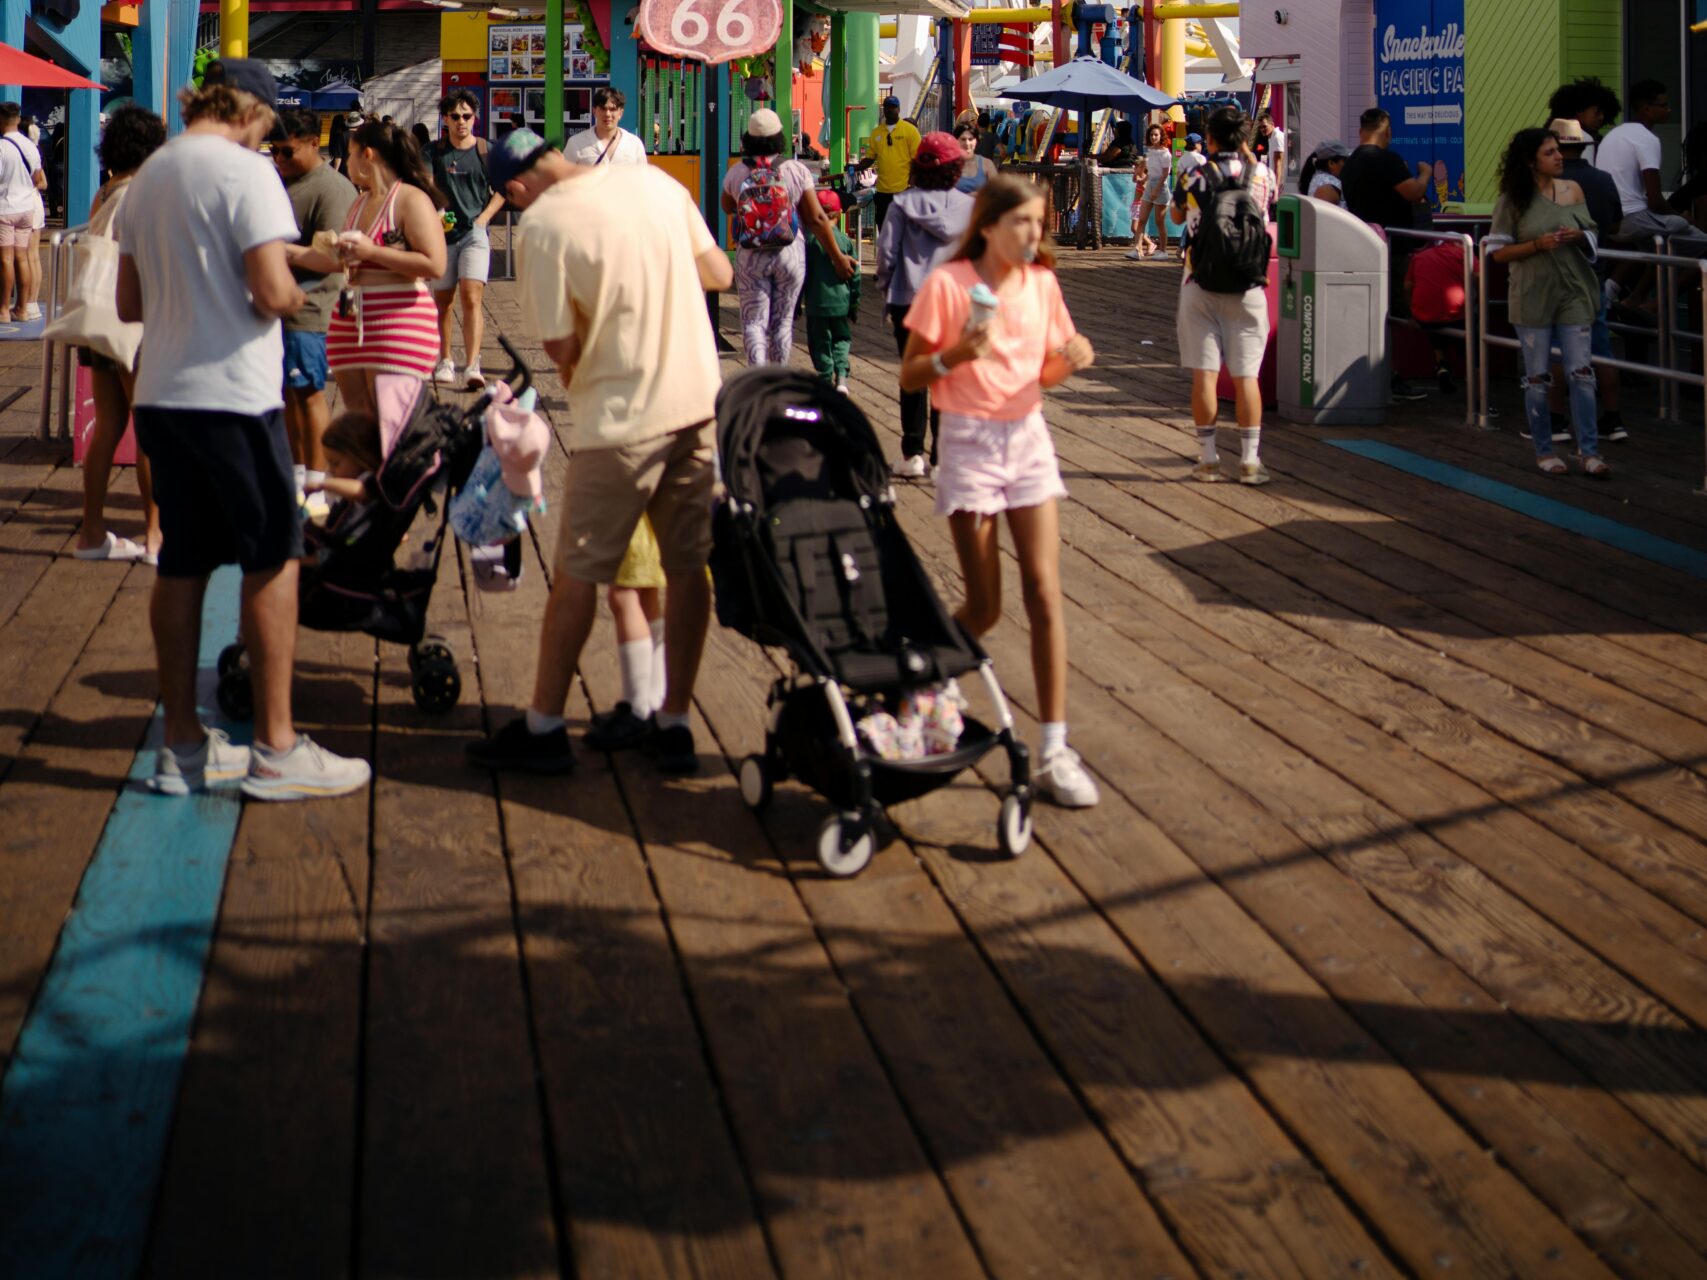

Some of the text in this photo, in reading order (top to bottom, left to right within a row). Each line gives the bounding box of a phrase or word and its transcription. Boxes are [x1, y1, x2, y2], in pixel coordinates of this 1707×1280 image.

[1380, 22, 1464, 64] Snackville
[1381, 67, 1440, 96] PACIFIC
[1417, 111, 1426, 119] WAY
[1302, 295, 1313, 384] COMPOST ONLY
